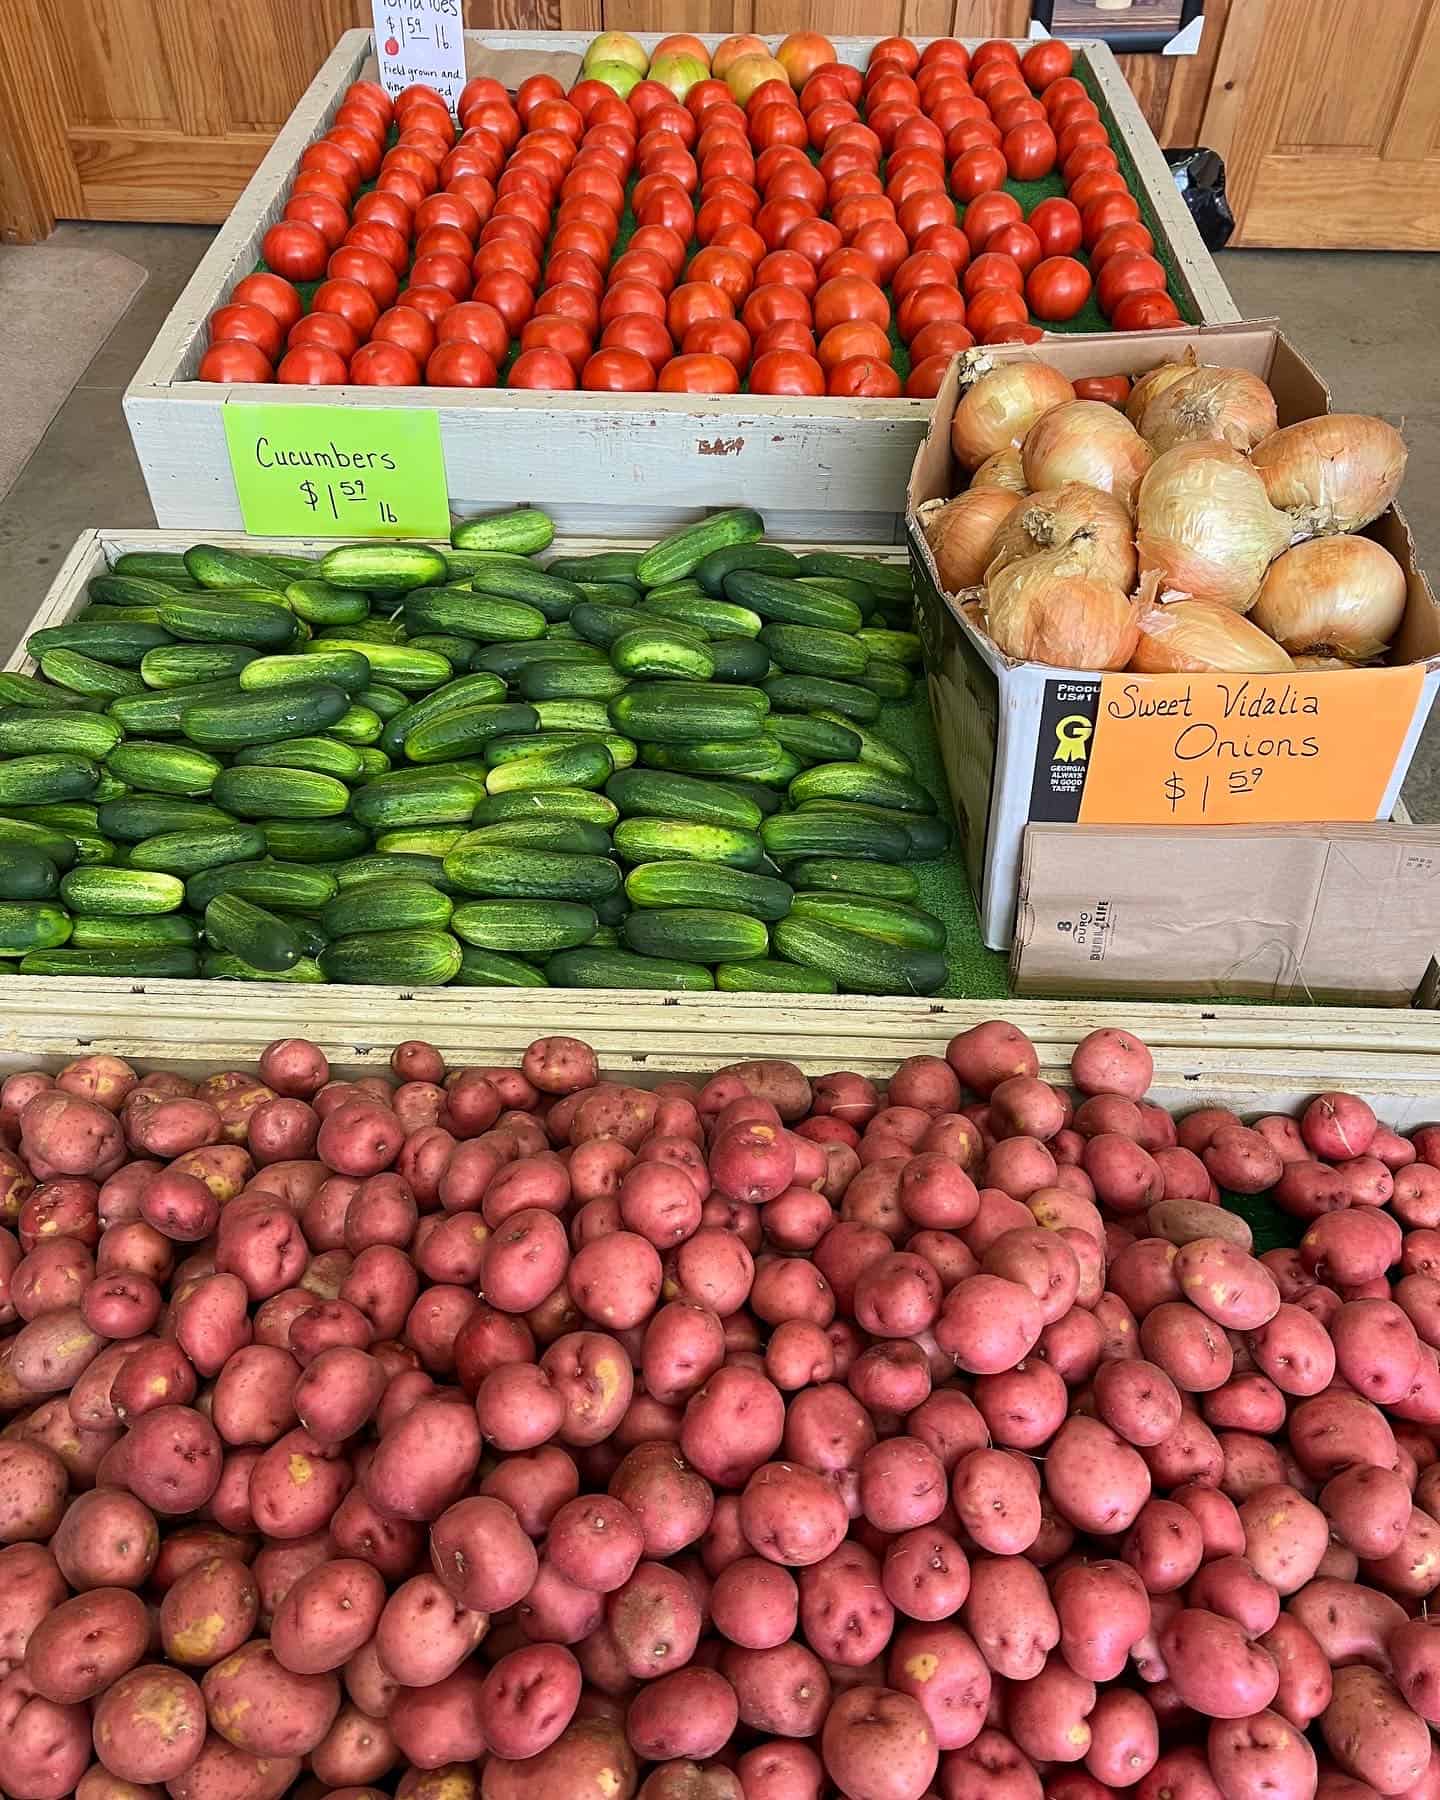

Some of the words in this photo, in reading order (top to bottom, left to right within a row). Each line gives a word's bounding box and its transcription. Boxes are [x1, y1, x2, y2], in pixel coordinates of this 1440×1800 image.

[383, 61, 405, 75] Field
[407, 68, 437, 81] grown
[441, 69, 463, 79] and
[256, 437, 396, 470] Cucumbers
[379, 502, 398, 523] lb
[1057, 693, 1092, 701] US#1
[1107, 684, 1193, 719] Sweet
[1217, 681, 1319, 718] Vidalia
[1174, 723, 1320, 760] Onions
[1057, 921, 1072, 932] 8
[1078, 912, 1088, 944] DURO
